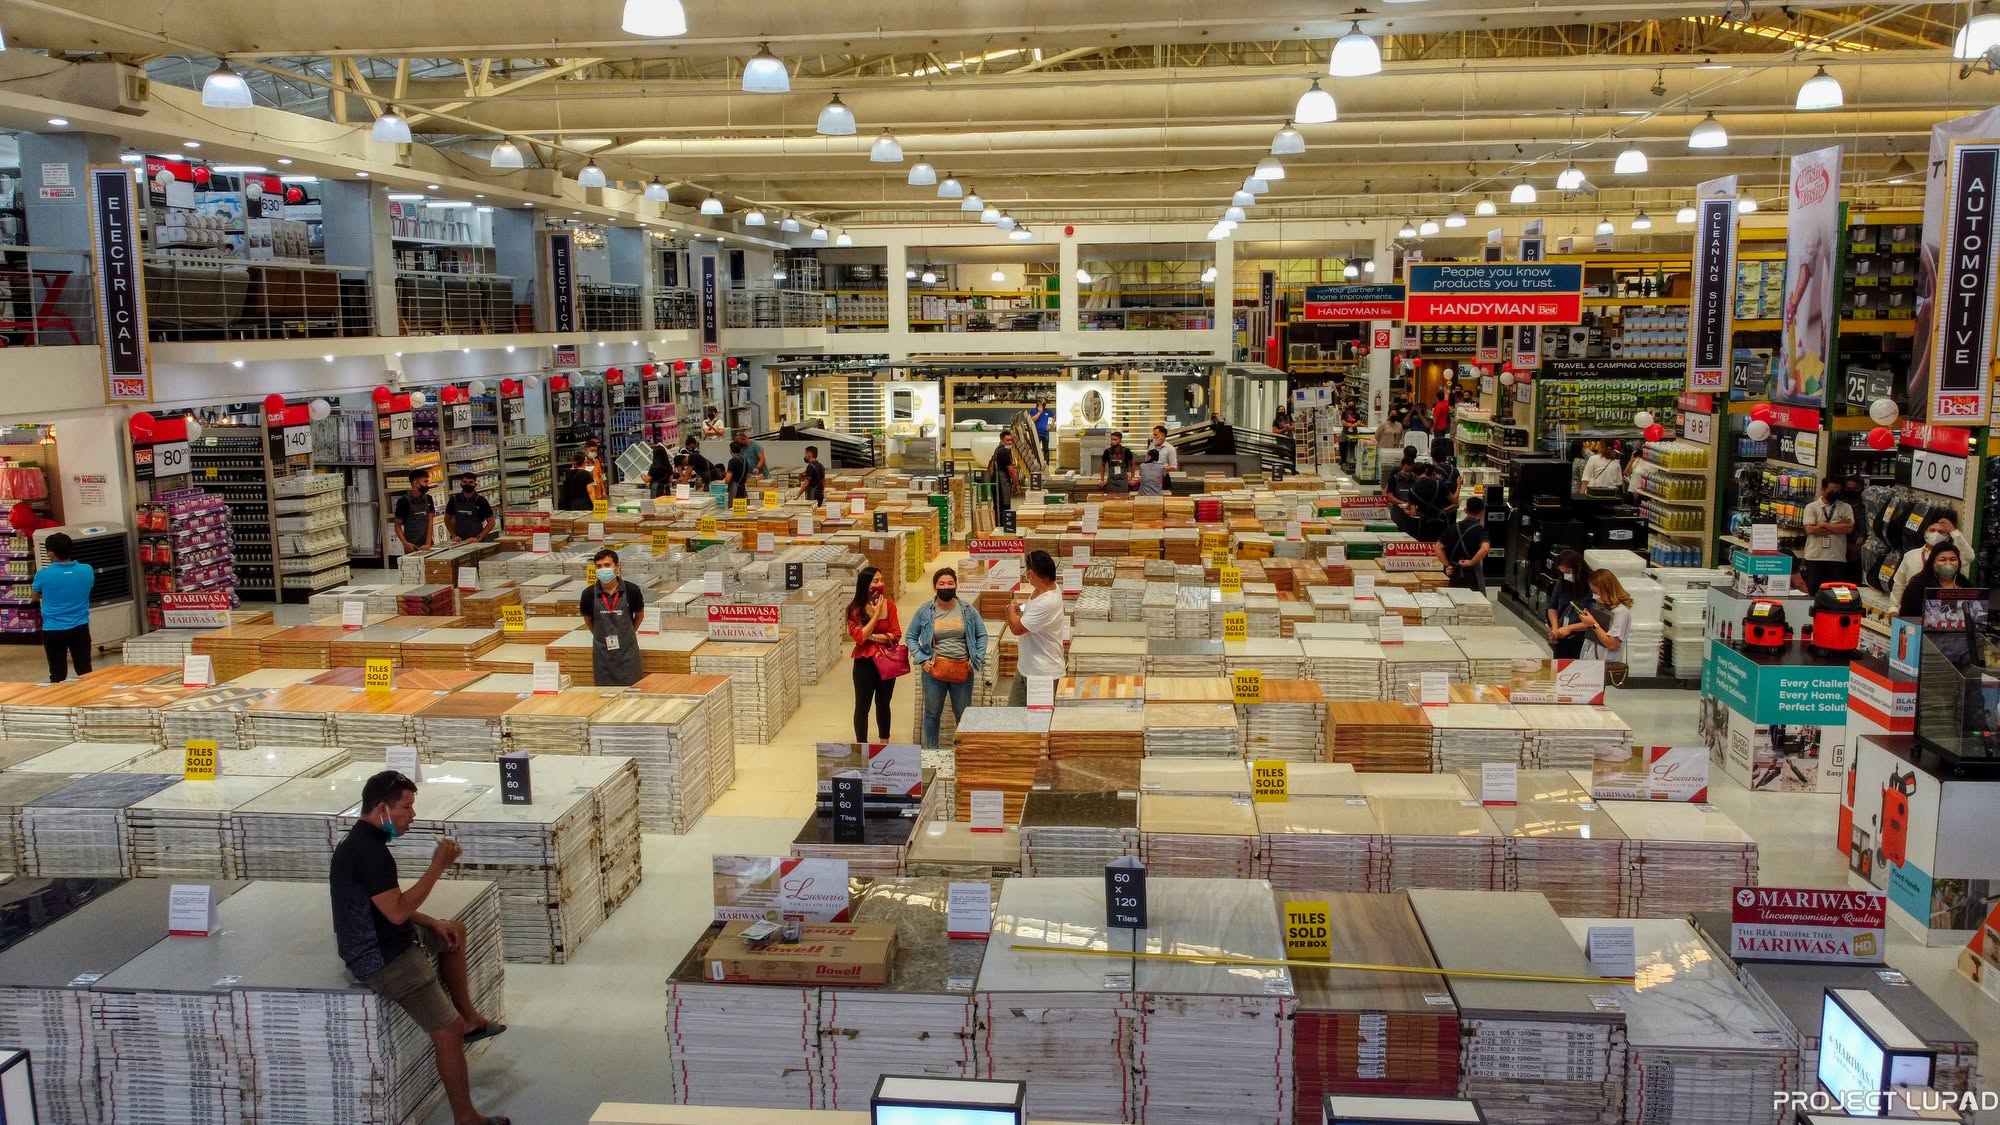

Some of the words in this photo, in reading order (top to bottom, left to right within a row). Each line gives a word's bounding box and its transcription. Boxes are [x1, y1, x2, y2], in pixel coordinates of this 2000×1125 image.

[262, 199, 280, 212] 630
[1710, 212, 1722, 282] CLEANING
[108, 197, 132, 355] ELECTRICAL
[1441, 266, 1485, 279] People
[1489, 267, 1512, 279] you
[1516, 266, 1551, 277] know
[1956, 177, 1985, 365] AUTOMOTIVE
[557, 249, 569, 331] ELECTRICA
[1433, 279, 1491, 290] products
[1495, 279, 1519, 290] you
[1522, 279, 1556, 288] trust.
[1347, 287, 1375, 295] partner
[705, 274, 714, 328] PLUMBING
[1317, 307, 1379, 316] HANDYMAN
[1430, 303, 1535, 315] HANDYMAN
[1538, 305, 1557, 315] Best
[1705, 291, 1717, 360] SUPPLIES
[558, 355, 575, 363] Best
[1481, 350, 1498, 359] Best
[1518, 355, 1535, 364] Best
[1694, 374, 1722, 386] Best
[1734, 365, 1747, 386] 24
[113, 381, 144, 395] Best
[1848, 376, 1866, 402] 25
[1938, 398, 1978, 415] Best
[454, 410, 468, 422] 180
[397, 418, 408, 431] 70
[285, 432, 306, 447] 140
[135, 451, 153, 465] Best
[164, 450, 182, 466] 80
[1898, 454, 1911, 463] From
[1915, 459, 1951, 484] 700
[172, 594, 226, 603] MARIWASA
[720, 606, 776, 615] MARIWASA
[168, 616, 216, 624] MARIWASA
[712, 629, 763, 637] MARIWASA
[1236, 676, 1259, 684] TILES
[1780, 679, 1809, 689] Every
[1780, 691, 1808, 700] Every
[1811, 691, 1844, 700] Home.
[1779, 703, 1816, 712] Perfect
[188, 748, 213, 756] TILES
[187, 758, 213, 766] SOLD
[505, 762, 517, 770] 60
[872, 759, 918, 777] Luxurio
[1256, 768, 1284, 777] TILES
[1653, 763, 1704, 783] Luxurio
[1256, 779, 1284, 787] SOLD
[840, 801, 852, 809] 60
[1114, 874, 1129, 883] 60
[1892, 868, 1904, 882] Fixed
[1904, 878, 1920, 894] Handle
[784, 877, 844, 901] Luxurio
[1114, 898, 1137, 907] 120
[1758, 890, 1881, 911] MARIWASA
[718, 912, 766, 920] MARIWASA
[1116, 914, 1138, 923] Tiles
[1289, 913, 1326, 924] TILES
[1759, 909, 1839, 924] Uncompromising
[1842, 912, 1881, 927] Quality
[1289, 928, 1327, 938] SOLD
[1756, 928, 1778, 936] REAL
[1738, 937, 1849, 955] MARIWASA
[1855, 941, 1872, 952] HD
[816, 964, 862, 977] Dowell
[1834, 1039, 1875, 1090] MARIWASA
